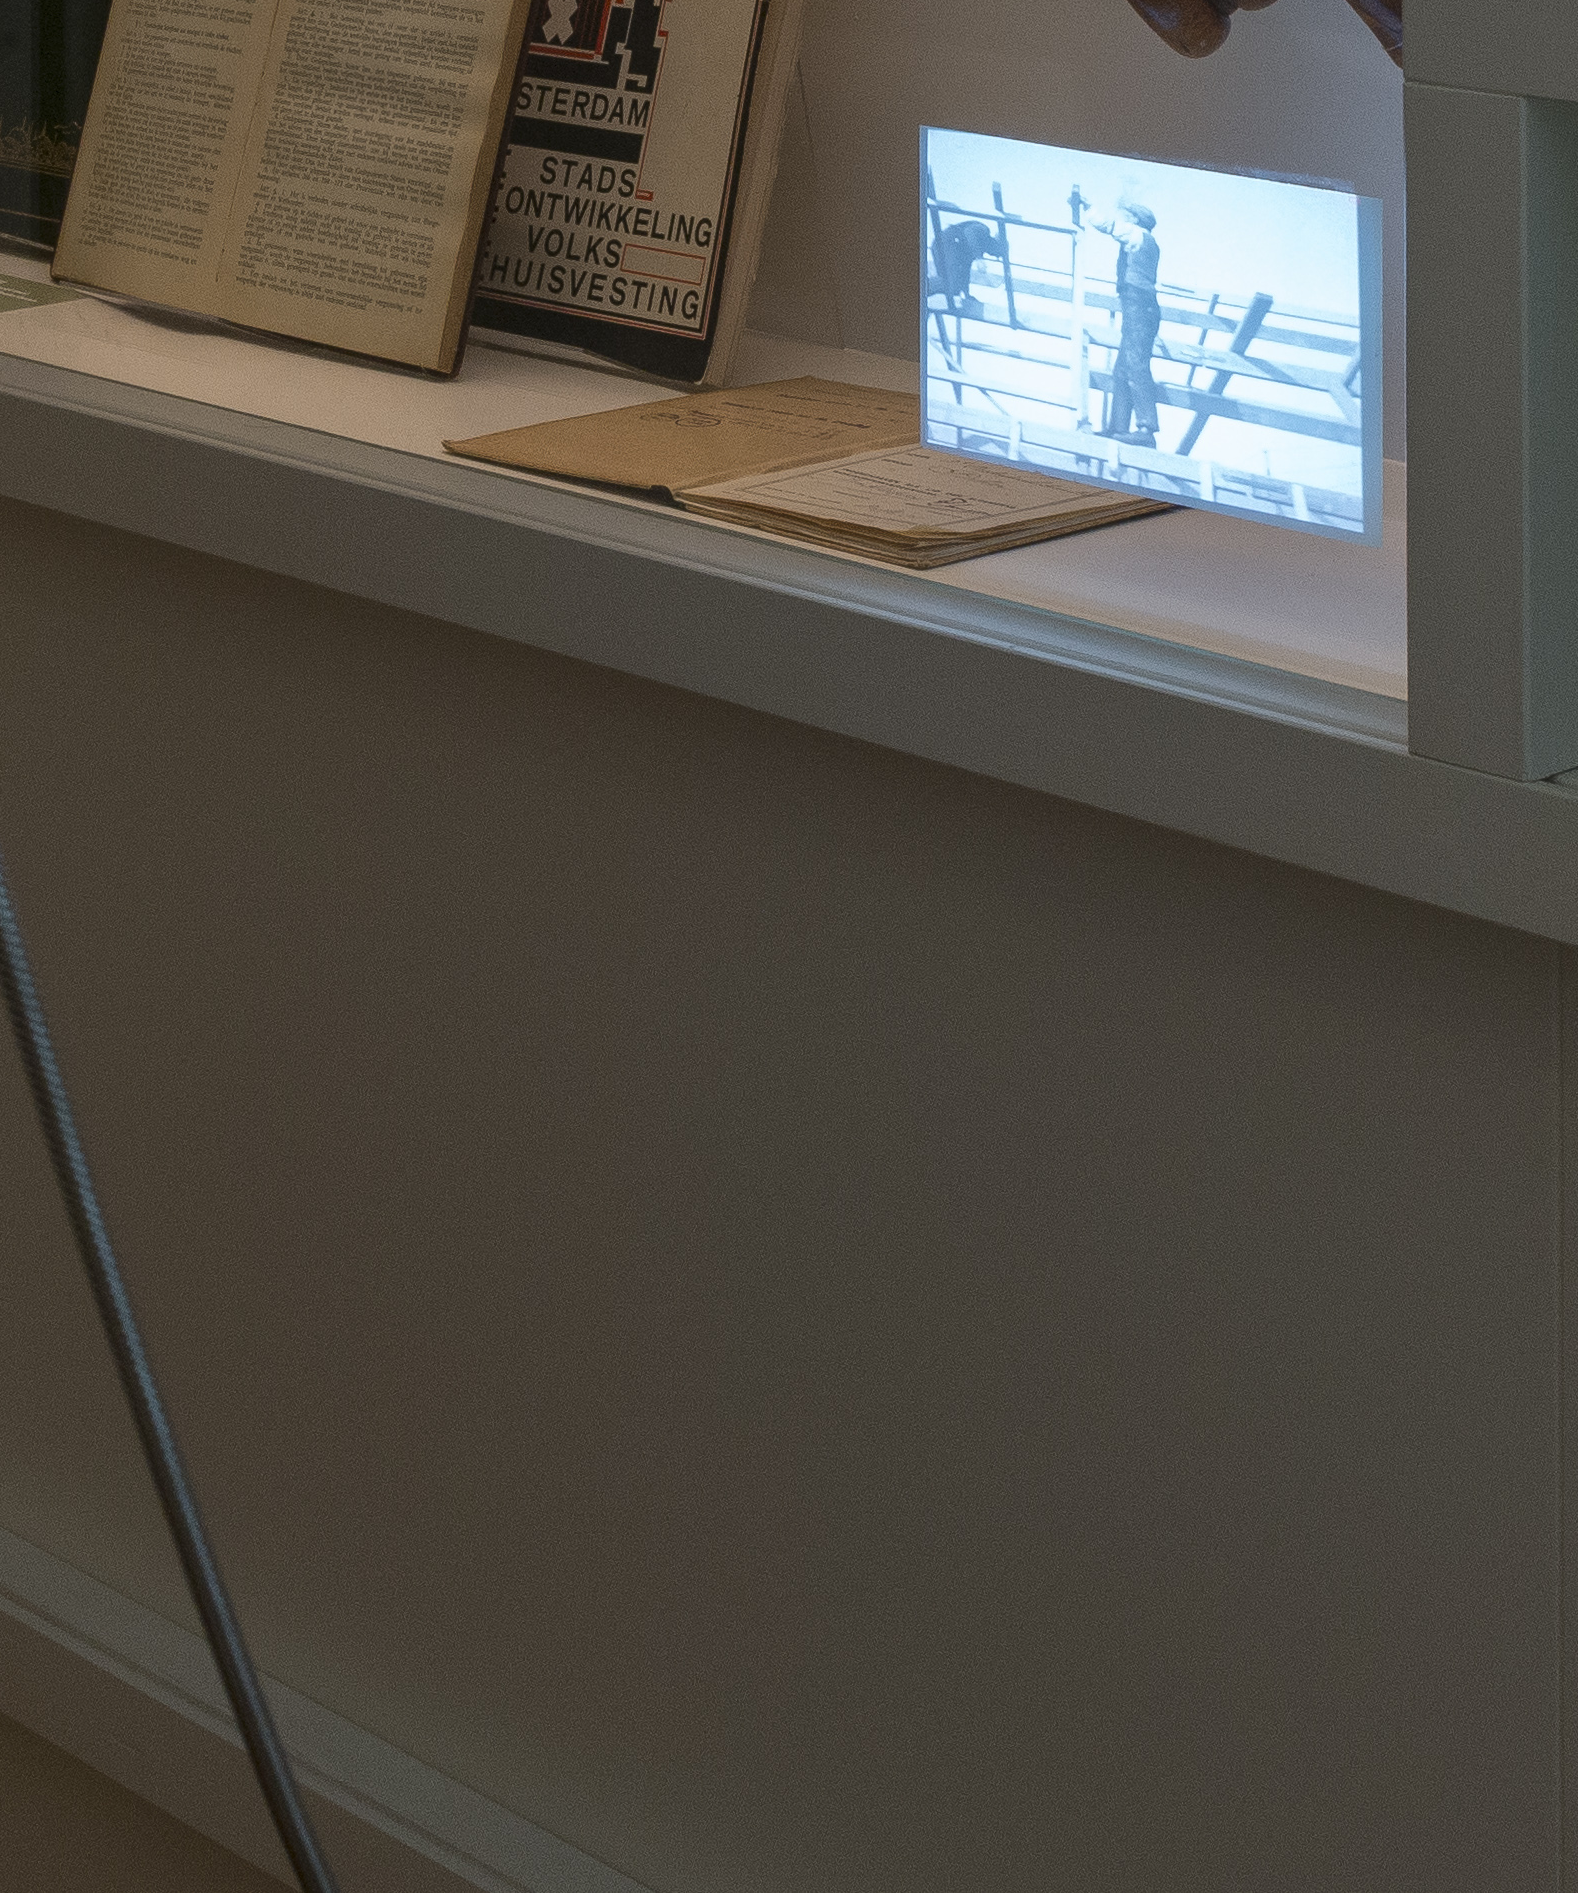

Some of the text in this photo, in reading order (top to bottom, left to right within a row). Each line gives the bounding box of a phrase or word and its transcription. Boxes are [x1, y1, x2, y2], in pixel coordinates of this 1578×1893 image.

[515, 81, 651, 129] STERDAM
[539, 156, 638, 199] STADS
[504, 185, 714, 249] ONTWIKKELING
[527, 224, 624, 269] VOLKS
[488, 253, 701, 321] HUISVESTING
